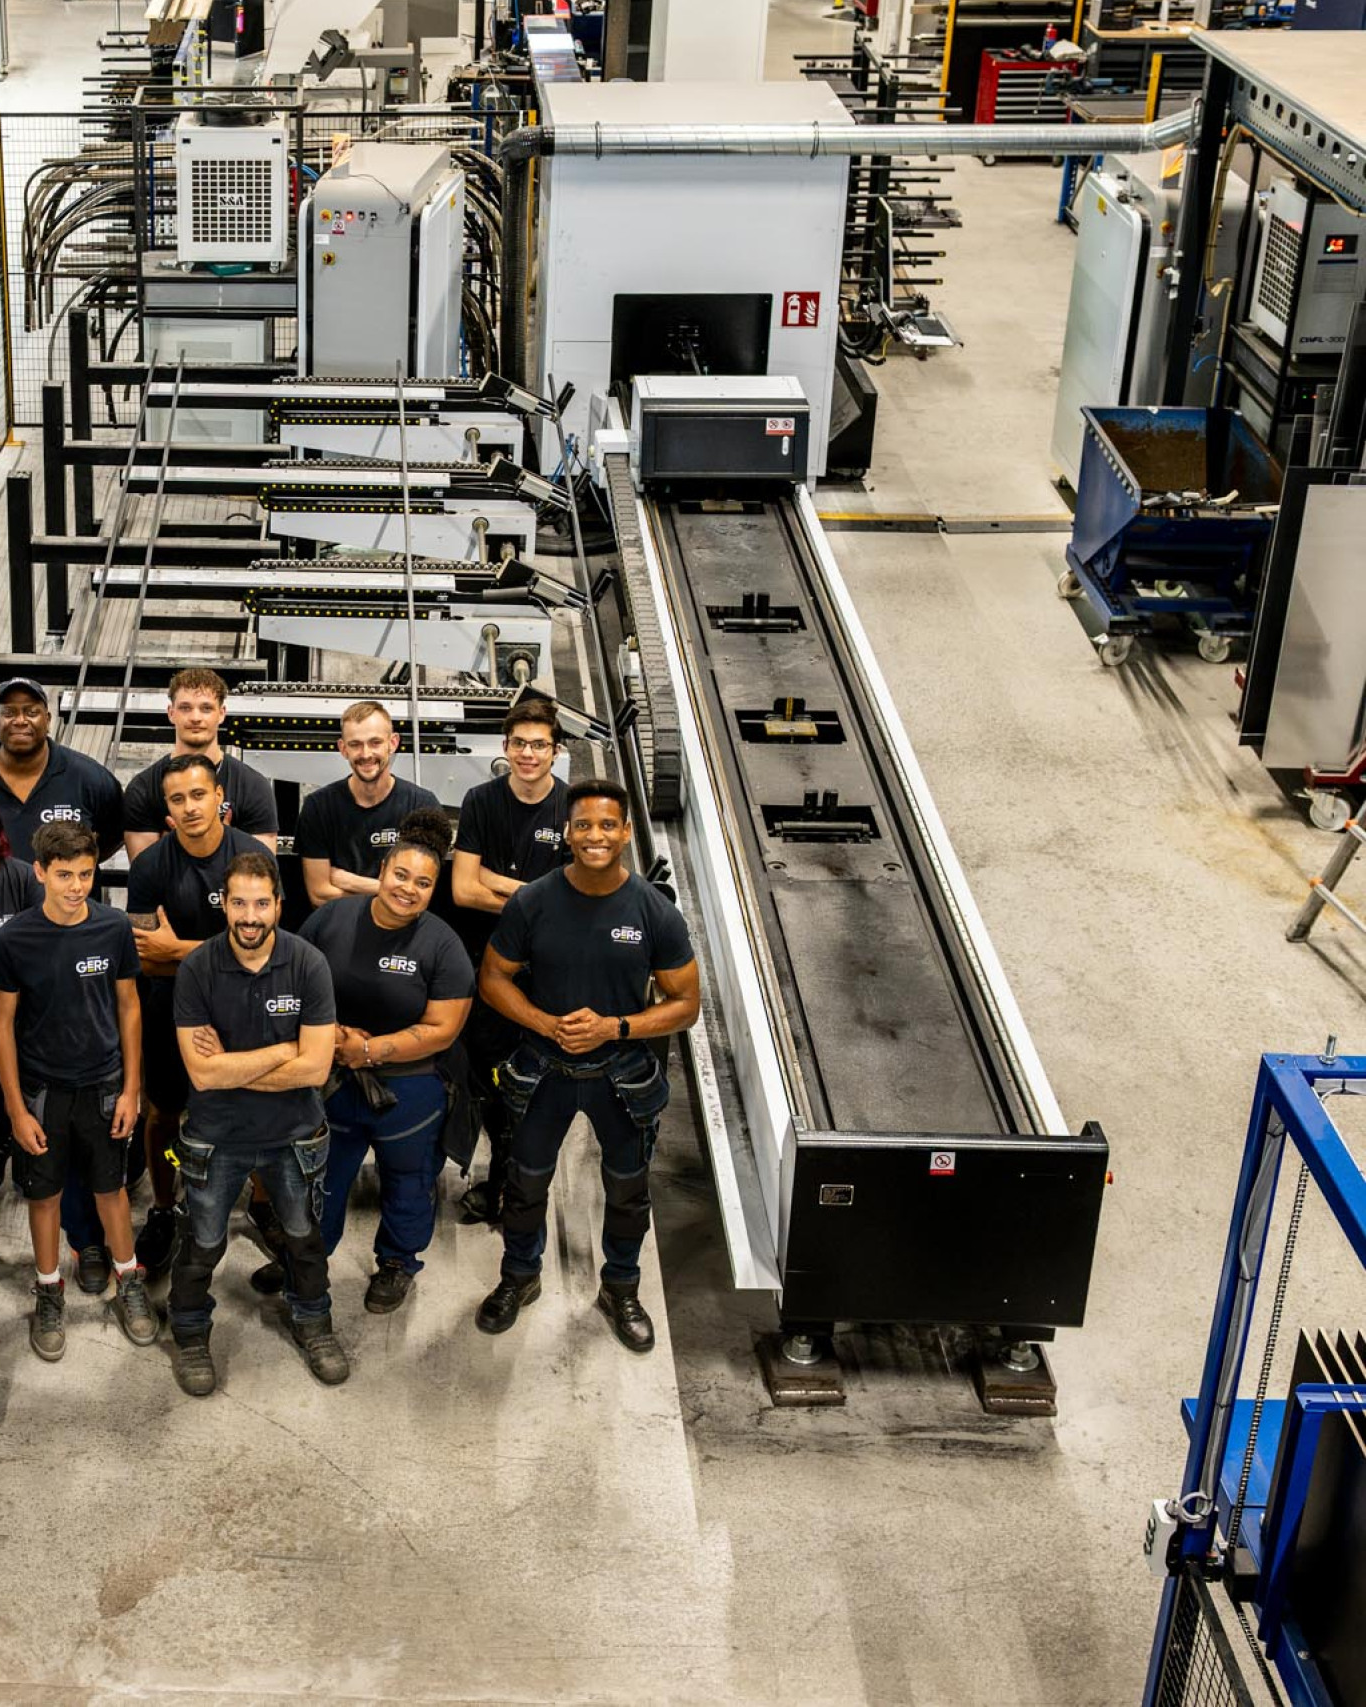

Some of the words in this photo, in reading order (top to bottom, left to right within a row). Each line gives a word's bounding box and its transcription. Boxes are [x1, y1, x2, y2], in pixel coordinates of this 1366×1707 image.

[40, 808, 81, 823] GERS
[534, 830, 561, 842] GERS
[611, 928, 643, 941] GERS
[75, 958, 109, 974] GERS
[378, 957, 417, 973] GERS
[266, 998, 301, 1013] GERS
